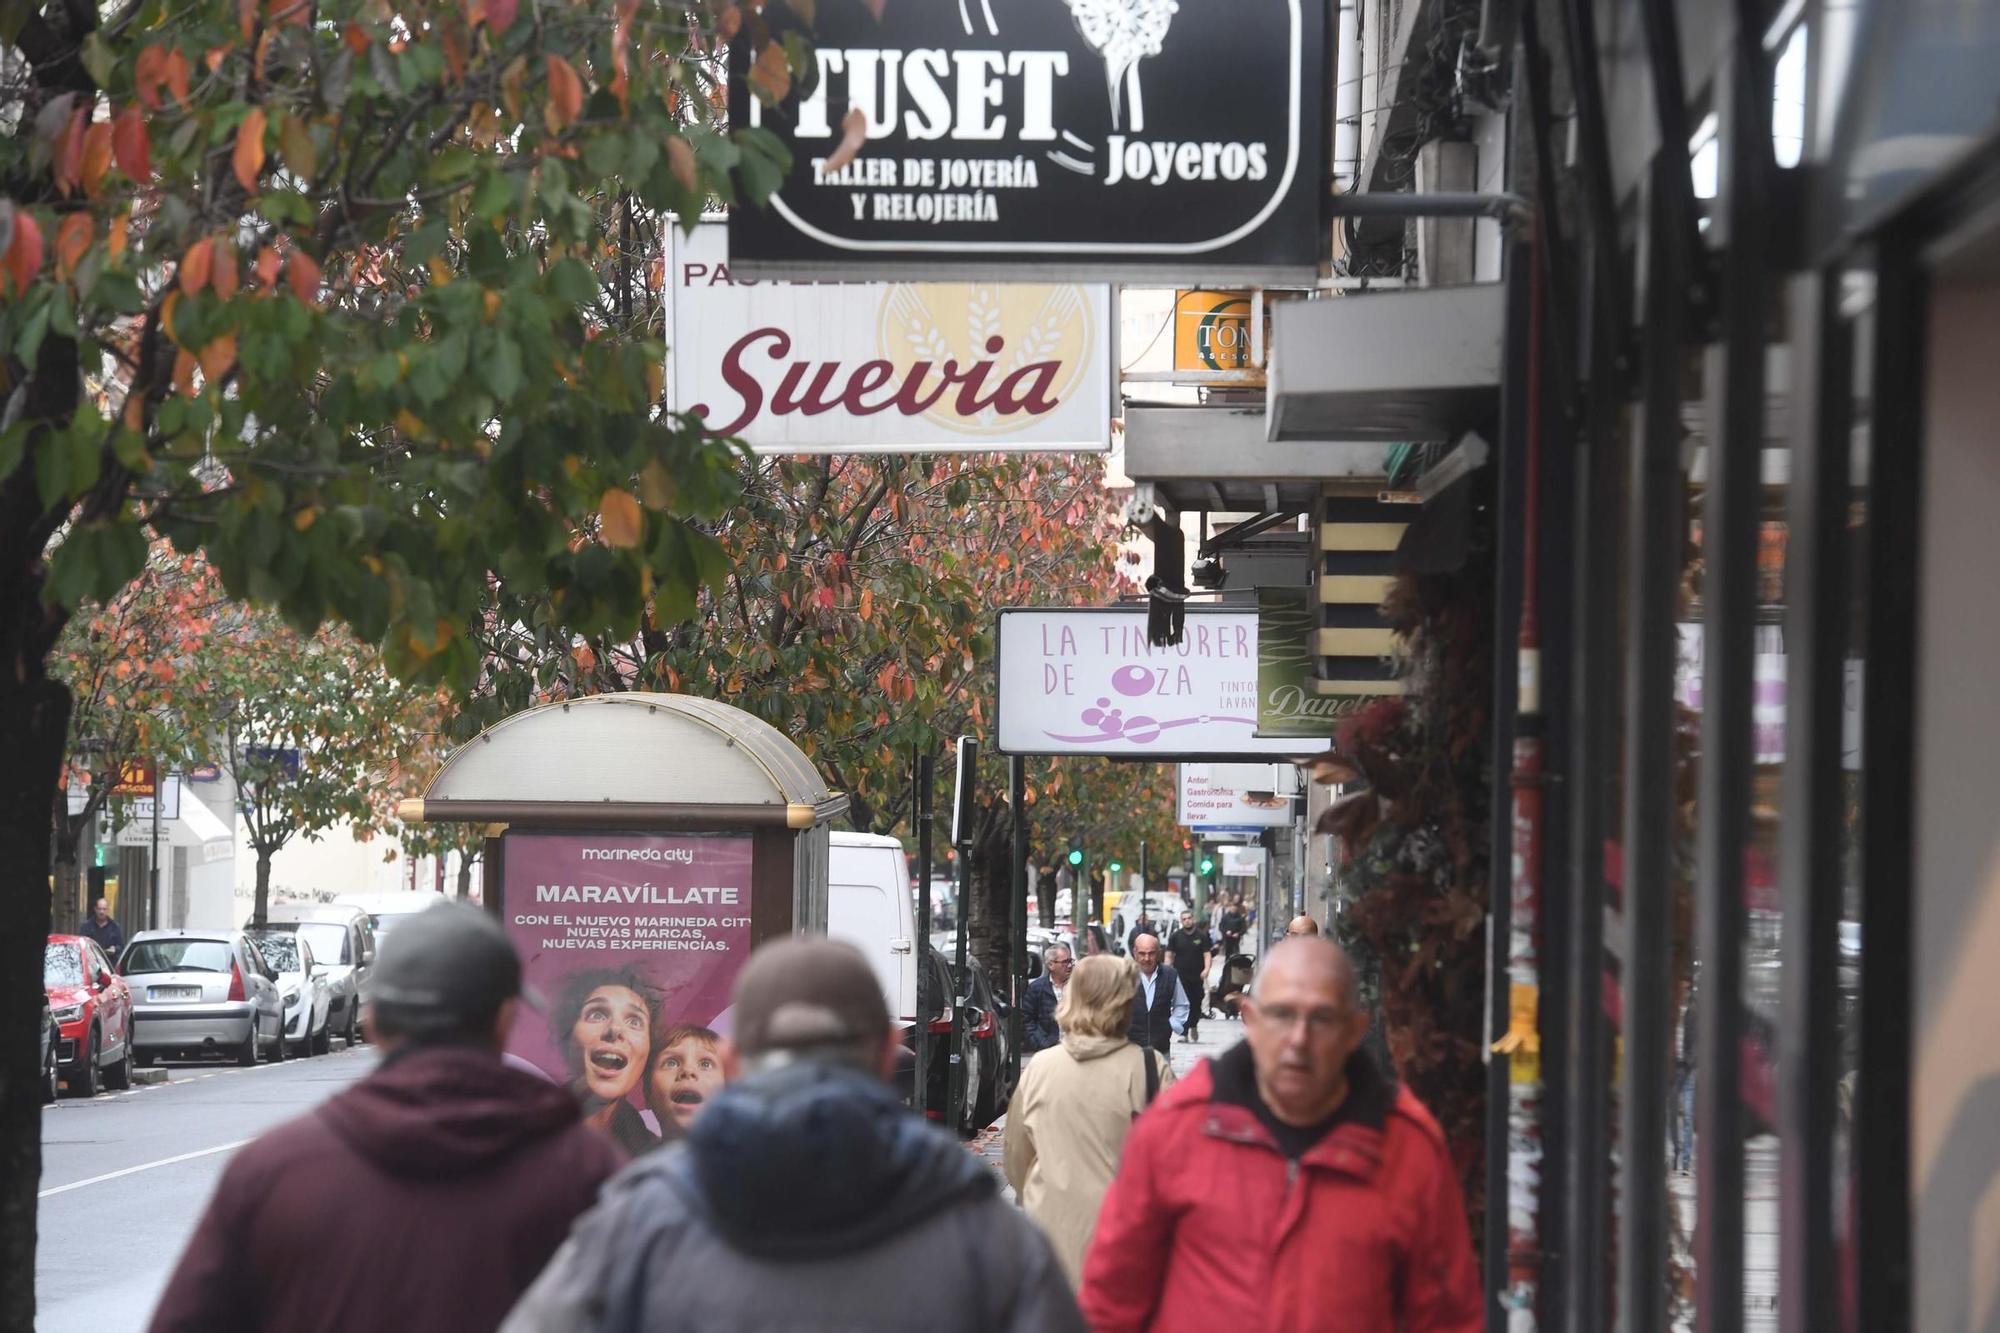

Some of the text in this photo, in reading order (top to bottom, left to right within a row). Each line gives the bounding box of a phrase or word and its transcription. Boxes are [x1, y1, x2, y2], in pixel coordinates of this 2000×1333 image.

[794, 48, 1069, 140] TUSET
[1105, 135, 1268, 185] Joyeros
[811, 155, 1039, 190] TALLER DE JOYERÍA
[851, 189, 999, 224] Y RELOJERÍA
[1199, 352, 1249, 360] ASESO
[689, 327, 1063, 439] Suevia
[1042, 623, 1258, 658] LA TINORER
[1044, 663, 1075, 695] DE
[1220, 681, 1257, 692] TINTO
[1219, 697, 1256, 709] LAVAN
[1187, 800, 1233, 810] Comida para
[582, 848, 693, 864] marineda city
[536, 883, 738, 905] MARAVÍLLATE
[515, 915, 549, 925] CON
[553, 915, 572, 925] EL
[576, 916, 631, 926] NUEVO
[635, 916, 718, 927] MARINEDA
[567, 927, 706, 940] NUEVAS MARCAS,
[543, 939, 730, 951] NUEVAS EXPERIENCIAS.
